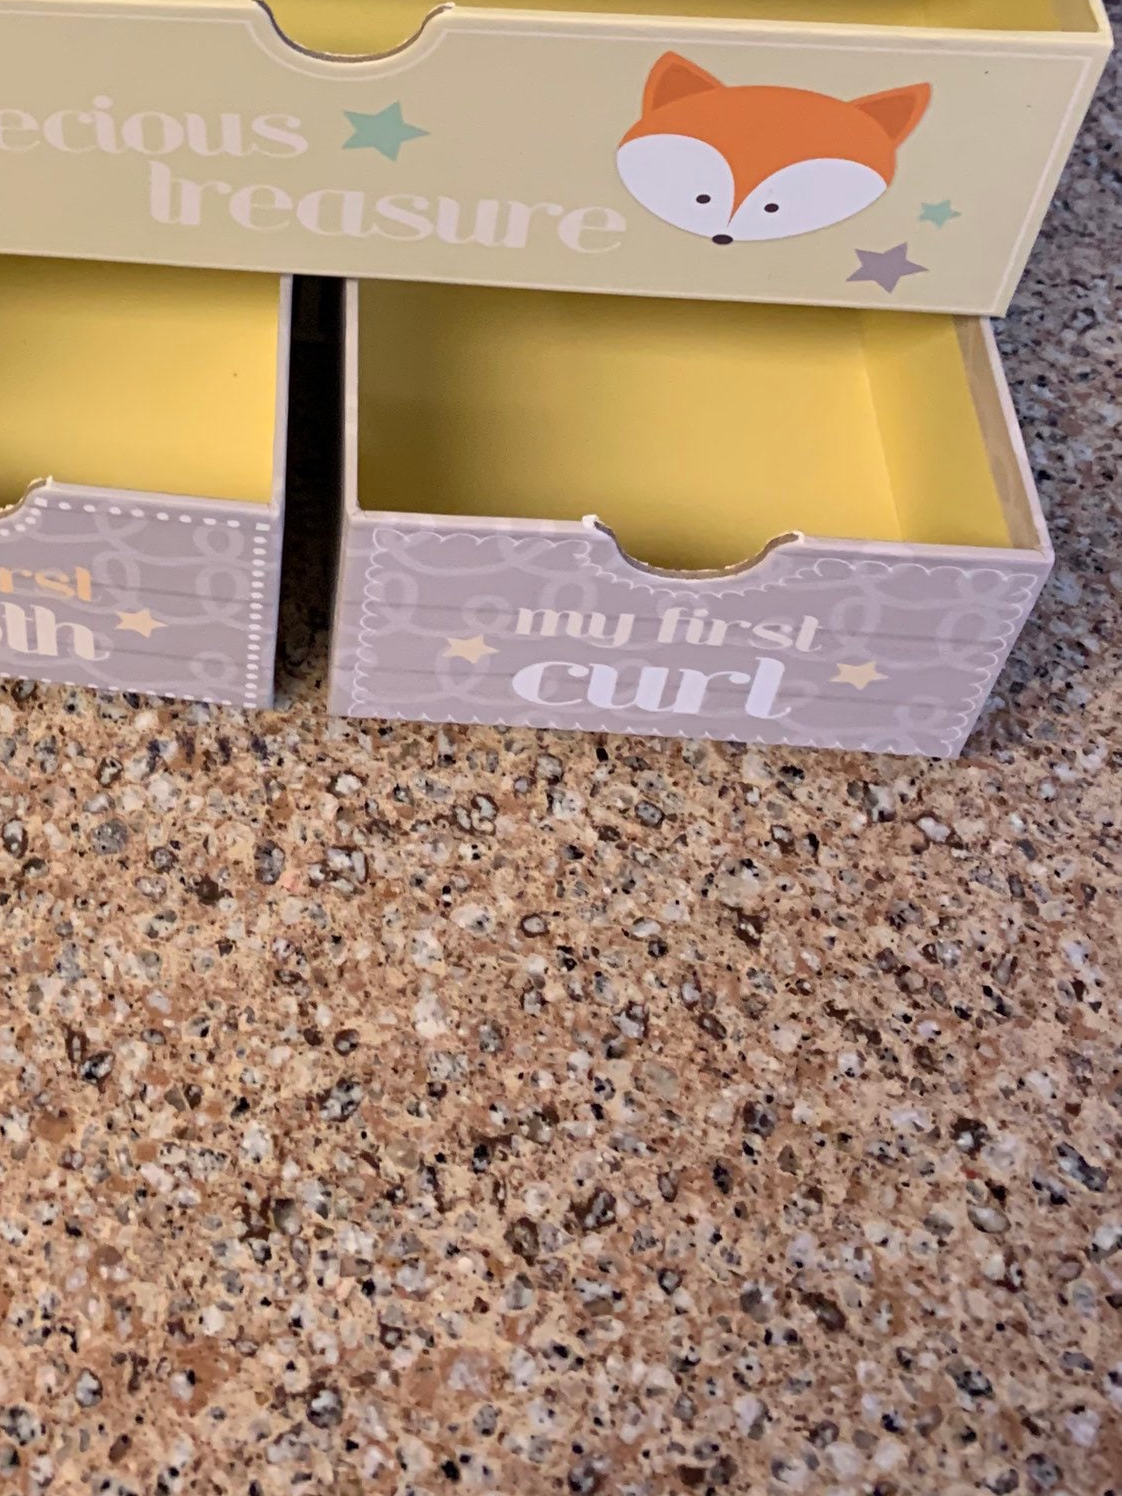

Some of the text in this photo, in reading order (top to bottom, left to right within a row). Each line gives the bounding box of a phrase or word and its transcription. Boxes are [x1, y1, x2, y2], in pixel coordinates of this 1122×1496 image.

[147, 160, 626, 254] treasure
[514, 606, 823, 653] my first
[512, 657, 792, 719] curl
